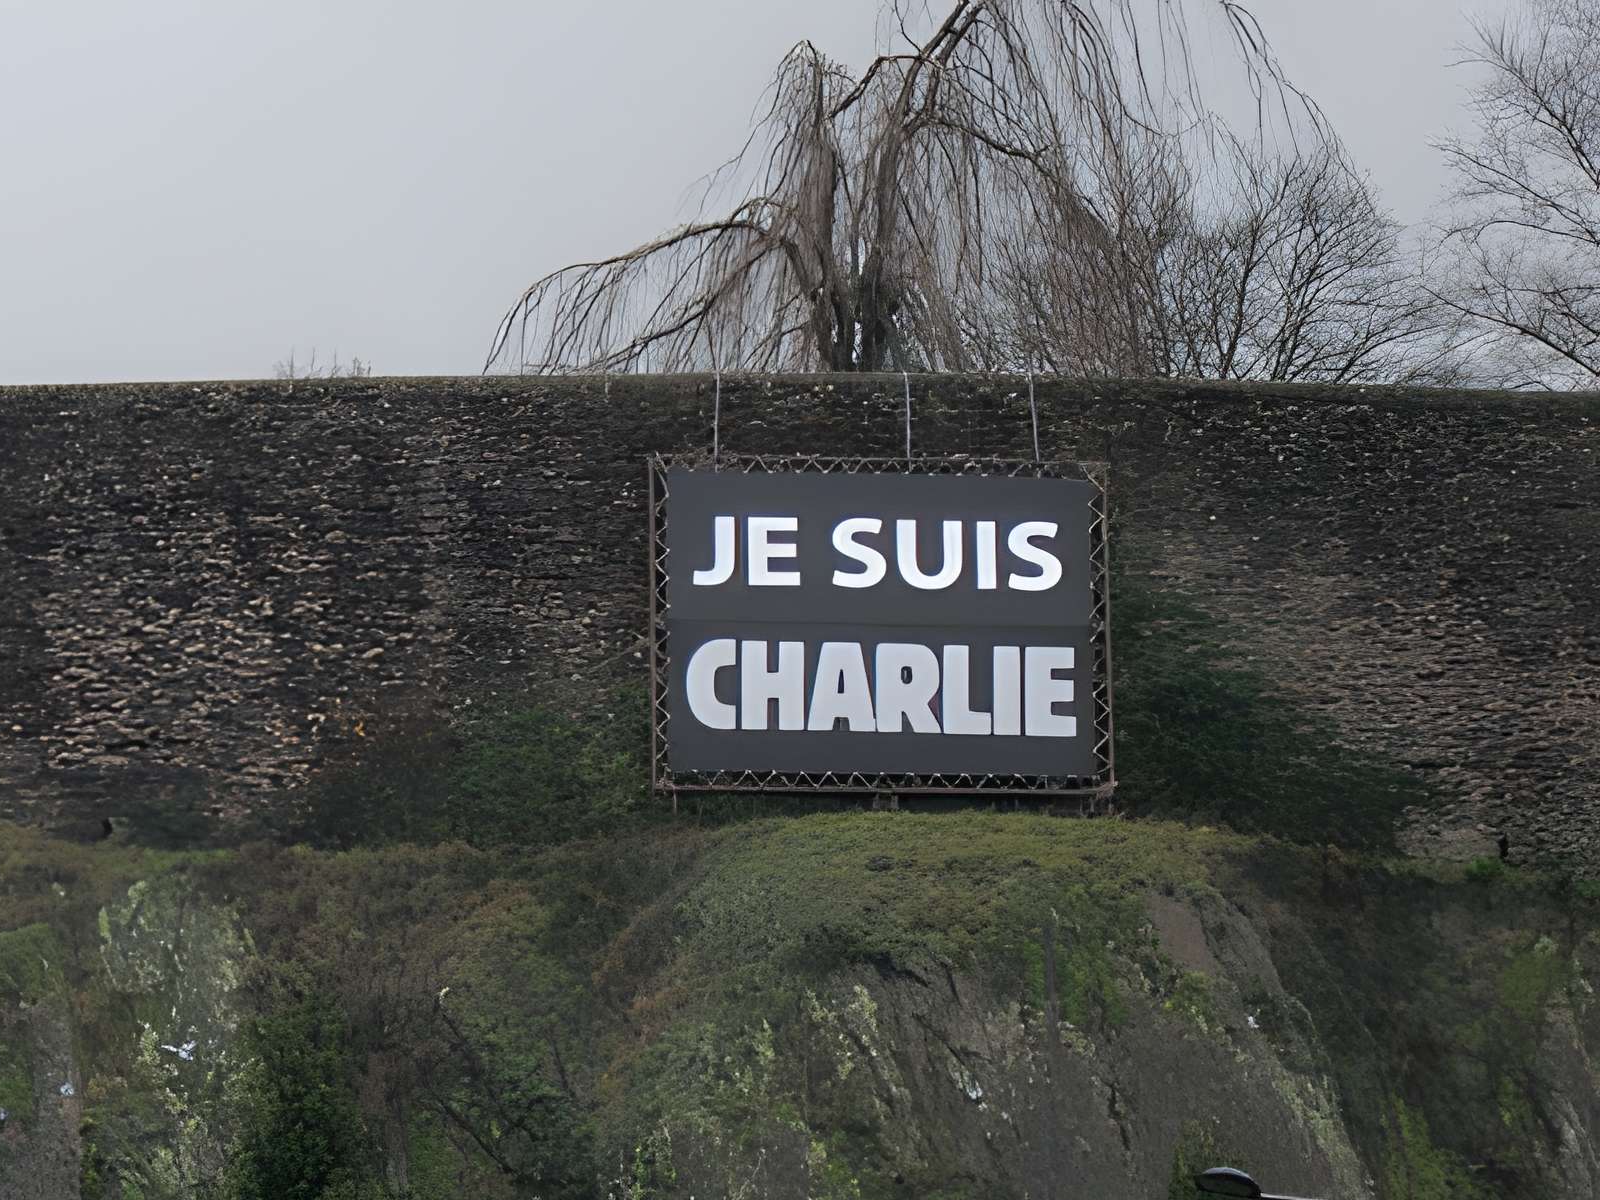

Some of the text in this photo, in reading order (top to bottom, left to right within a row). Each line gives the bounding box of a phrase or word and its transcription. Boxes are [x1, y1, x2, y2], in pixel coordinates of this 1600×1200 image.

[692, 515, 1063, 591] JE SUIS
[686, 638, 1077, 737] CHARLIE
